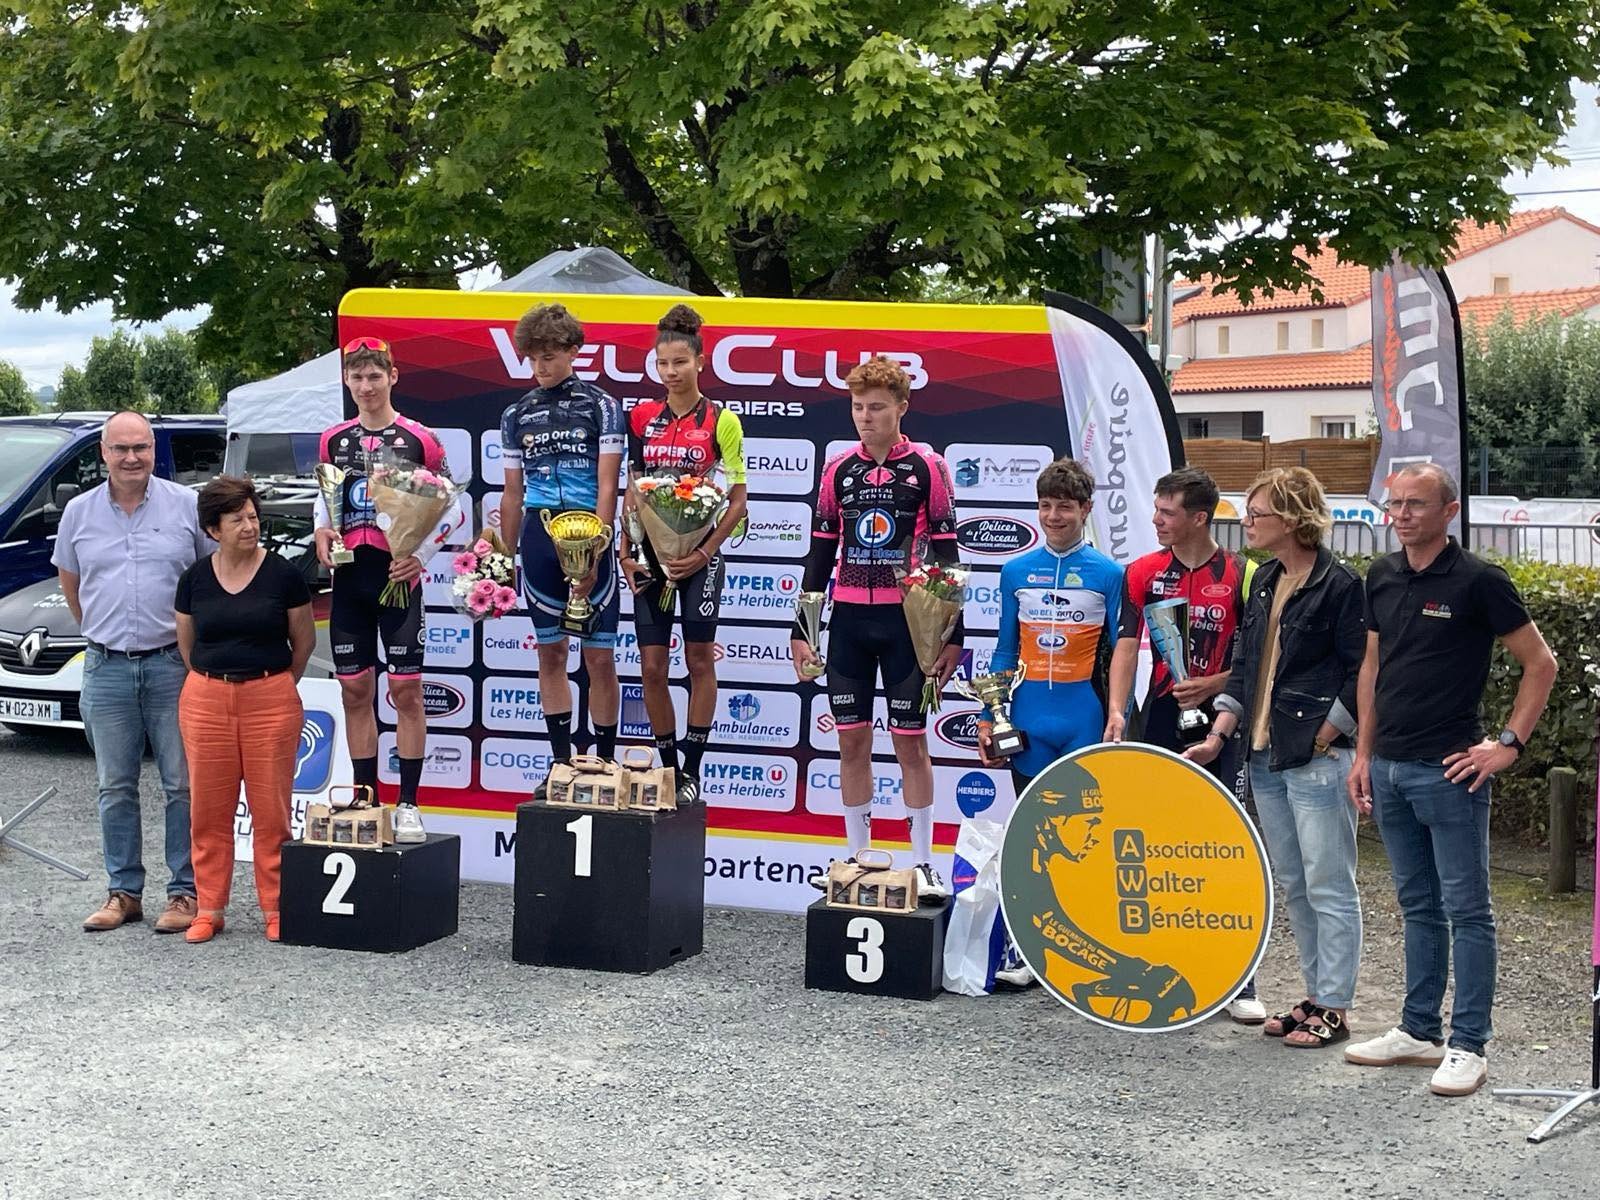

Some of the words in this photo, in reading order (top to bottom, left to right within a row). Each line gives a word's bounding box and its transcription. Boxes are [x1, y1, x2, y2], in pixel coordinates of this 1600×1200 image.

[643, 445, 687, 459] HYPER
[747, 456, 808, 471] ERALU
[979, 520, 1018, 532] Délices
[727, 575, 774, 591] YPER
[738, 593, 796, 609] Herbiers
[426, 645, 457, 655] ENDÉE
[485, 637, 520, 650] Crédit
[491, 688, 541, 705] HYPE
[14, 701, 35, 716] 023
[38, 703, 51, 718] XM
[490, 705, 511, 719] Les
[623, 724, 651, 736] Métal
[711, 720, 790, 737] Ambulances
[704, 763, 764, 781] HYPER
[702, 781, 725, 795] Les
[728, 782, 787, 798] Herbiers
[957, 786, 995, 797] HERBIERS
[566, 815, 593, 877] 1
[1120, 834, 1245, 859] Association
[322, 852, 356, 915] 2
[1119, 868, 1206, 893] Walter
[1126, 904, 1253, 930] Bénéteau
[1058, 923, 1088, 948] GUERRIER
[845, 917, 884, 983] 3
[1042, 925, 1108, 971] BOCAGE
